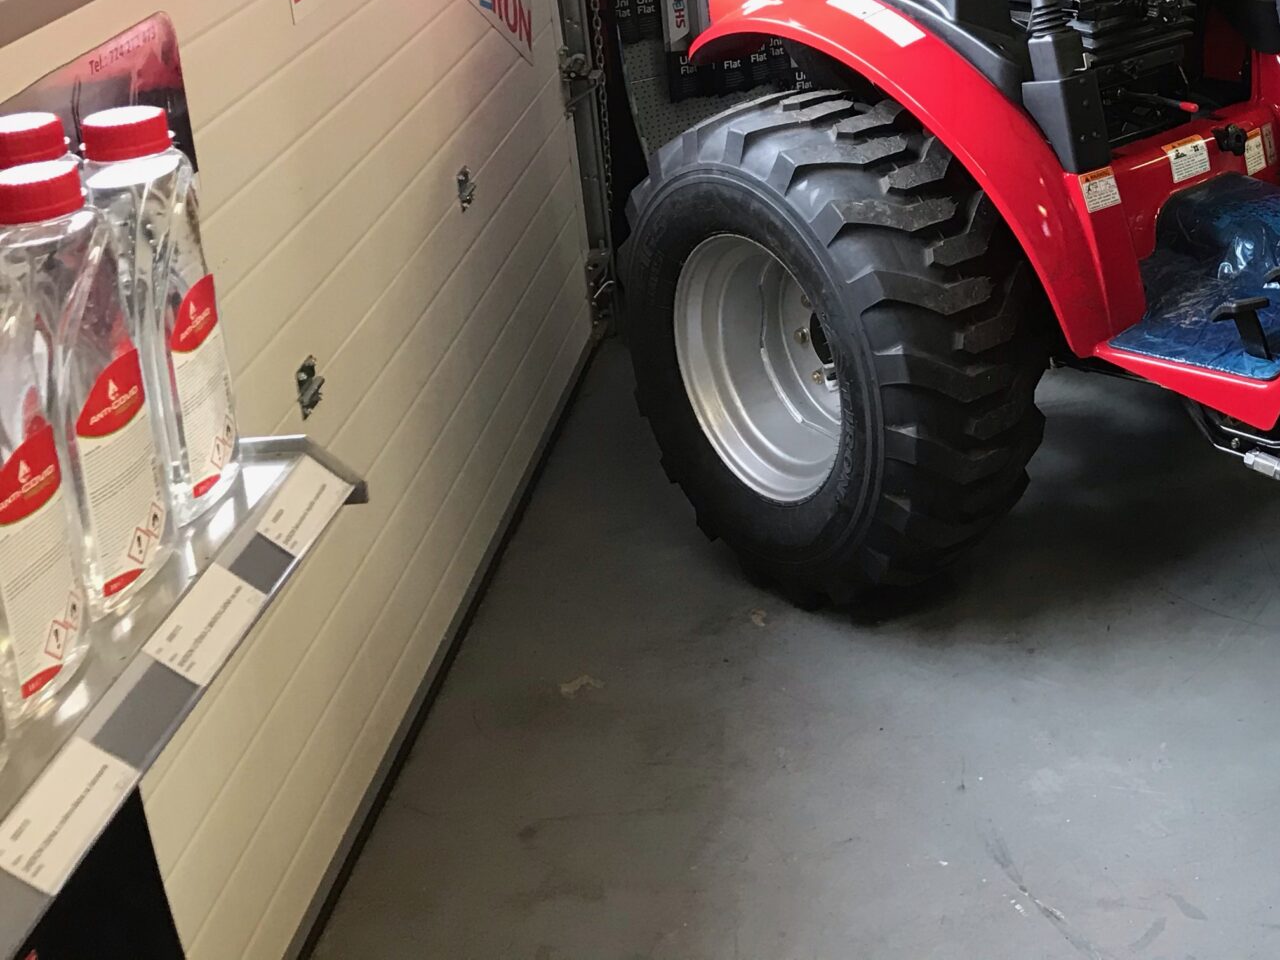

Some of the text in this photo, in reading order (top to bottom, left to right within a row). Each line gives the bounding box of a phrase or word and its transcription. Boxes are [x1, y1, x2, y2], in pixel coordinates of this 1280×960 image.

[637, 4, 656, 15] Flat
[750, 52, 767, 63] Flat
[724, 60, 741, 70] Flat
[89, 385, 139, 426] ANTI-COVID
